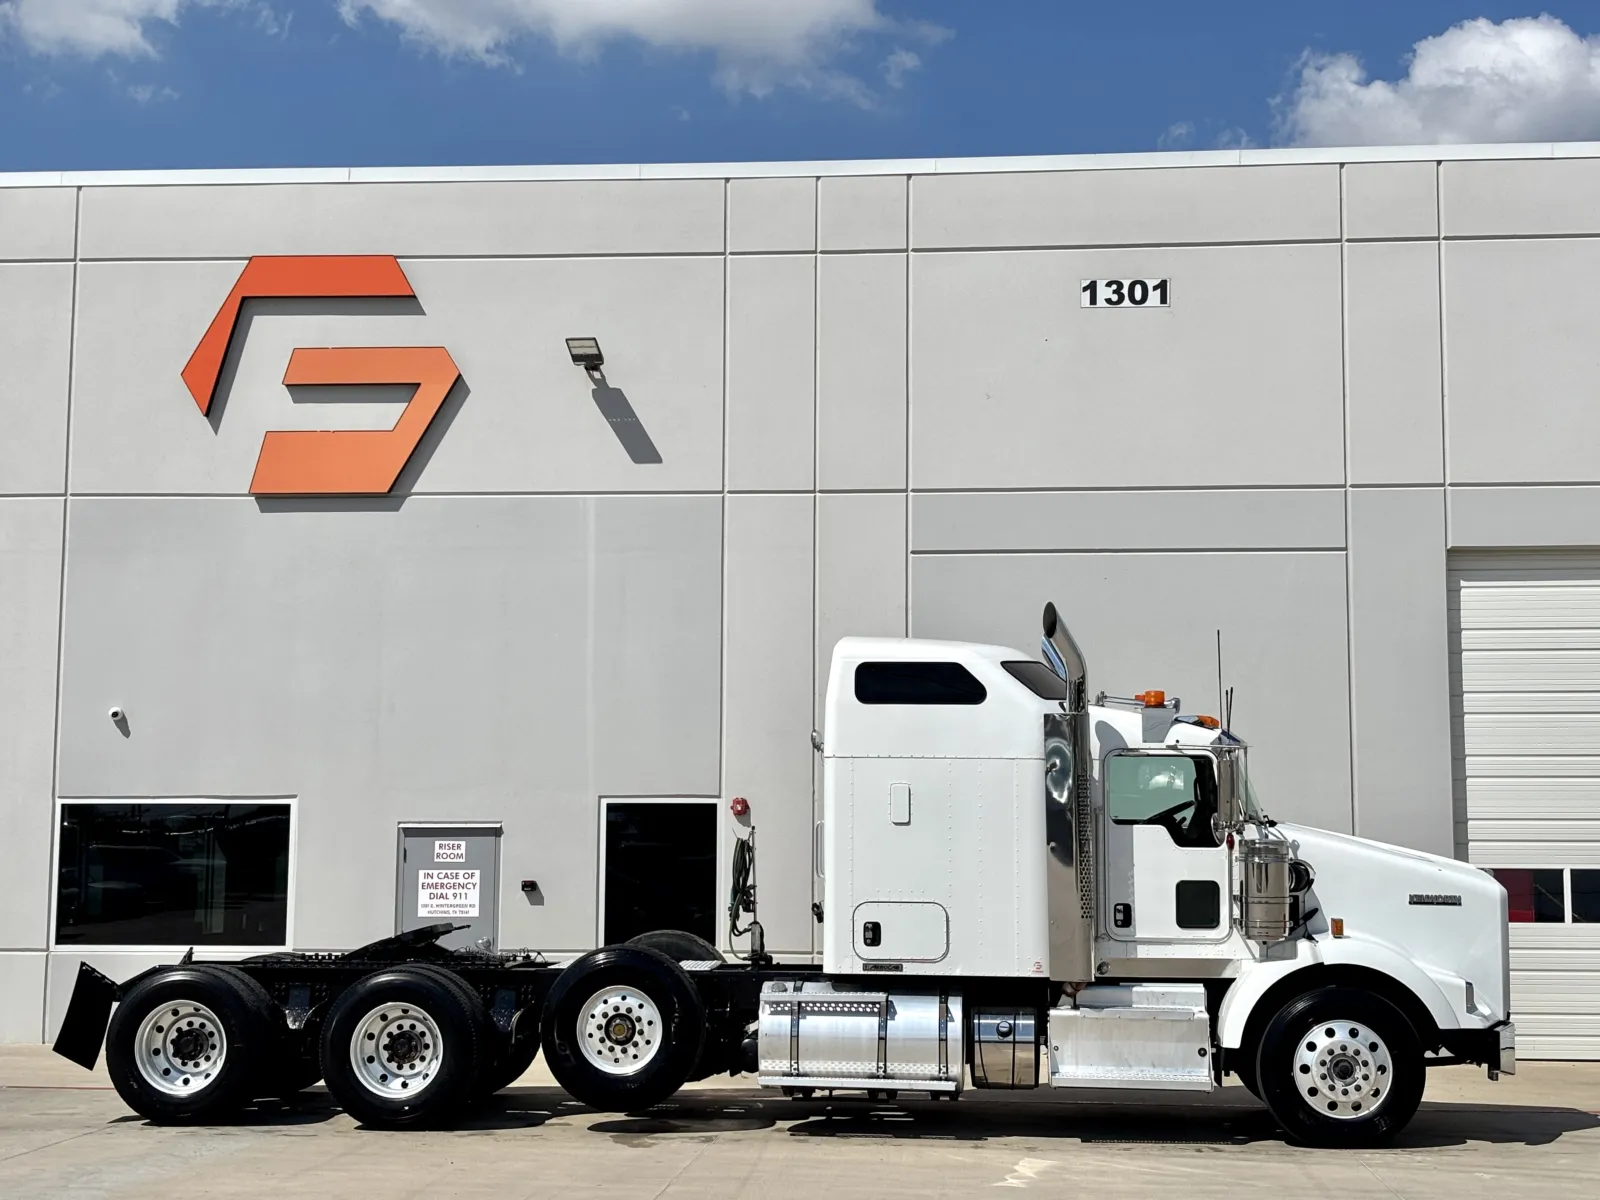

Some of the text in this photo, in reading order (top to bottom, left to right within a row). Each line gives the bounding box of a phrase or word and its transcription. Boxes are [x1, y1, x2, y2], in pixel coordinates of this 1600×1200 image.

[1082, 279, 1168, 306] 1301
[438, 843, 462, 851] RISER
[435, 852, 464, 860] ROOM
[423, 872, 476, 880] IN CASE OF
[421, 882, 477, 890] EMERGENCY
[429, 892, 468, 900] DIAL 911
